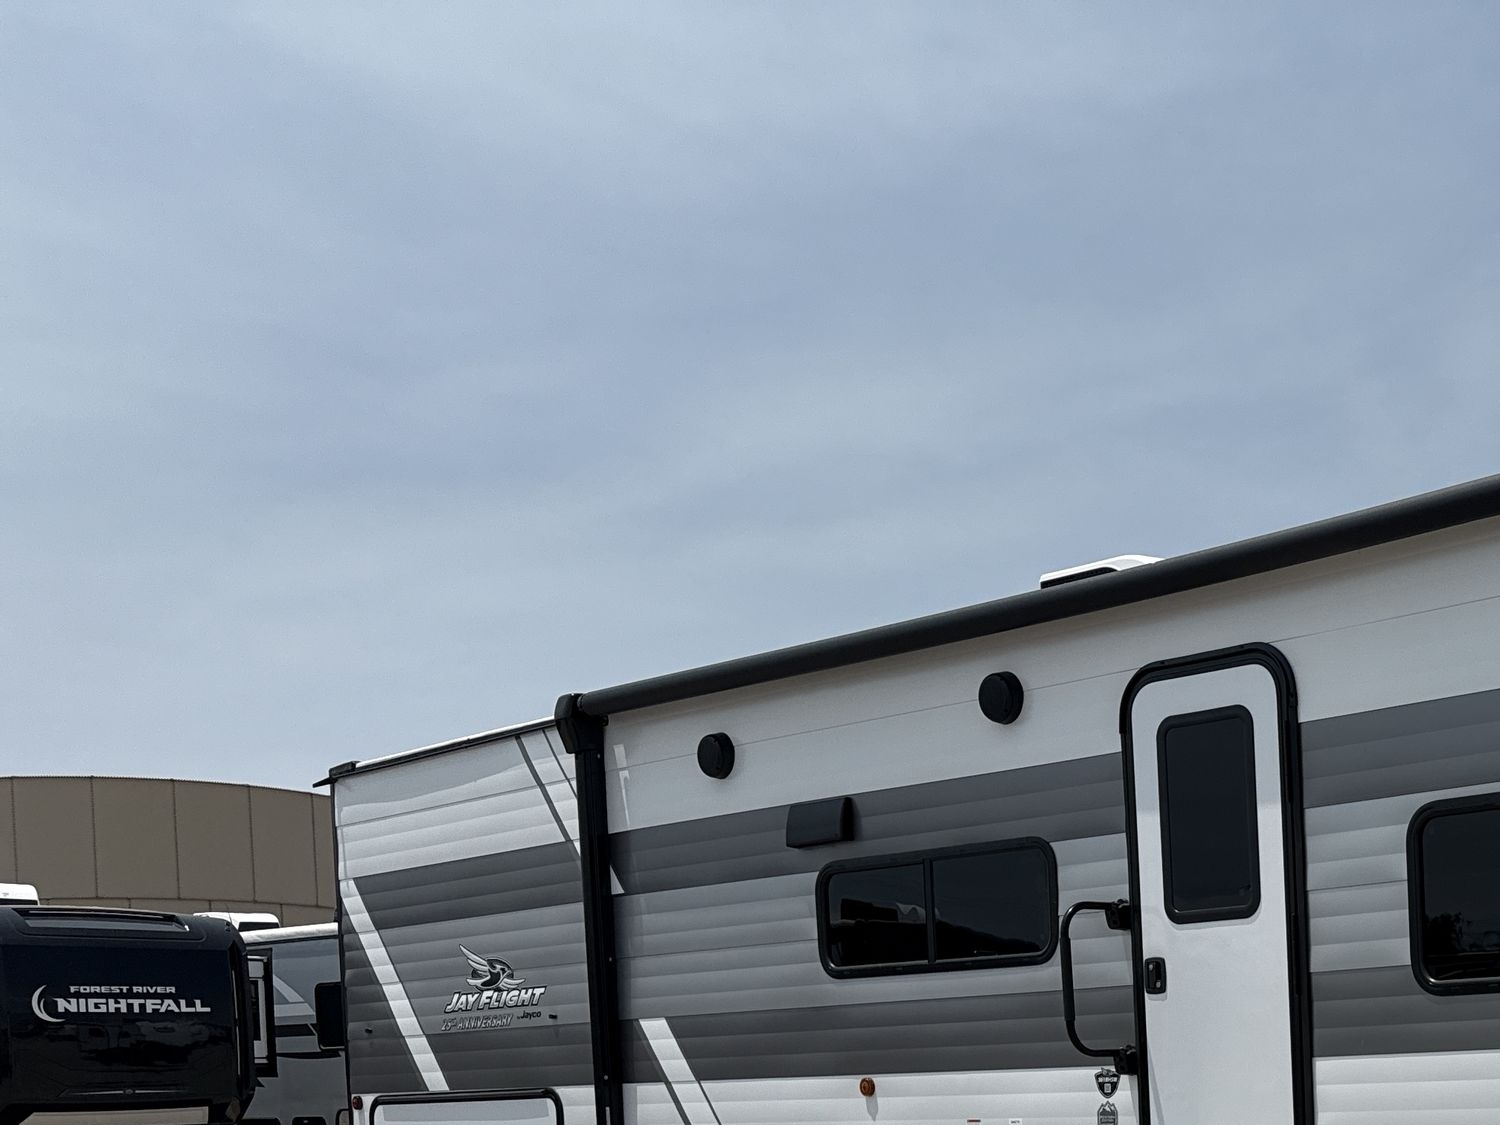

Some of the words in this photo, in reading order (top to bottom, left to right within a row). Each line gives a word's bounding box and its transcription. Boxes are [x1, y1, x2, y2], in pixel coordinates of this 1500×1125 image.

[68, 985, 130, 994] FOREST
[132, 986, 177, 994] RIVER
[53, 997, 212, 1014] NIGHTFALL
[445, 992, 480, 1013] JAY
[478, 986, 547, 1009] FLIGHT
[457, 1013, 514, 1031] ANNIVERSARY
[520, 1009, 542, 1021] Jayco
